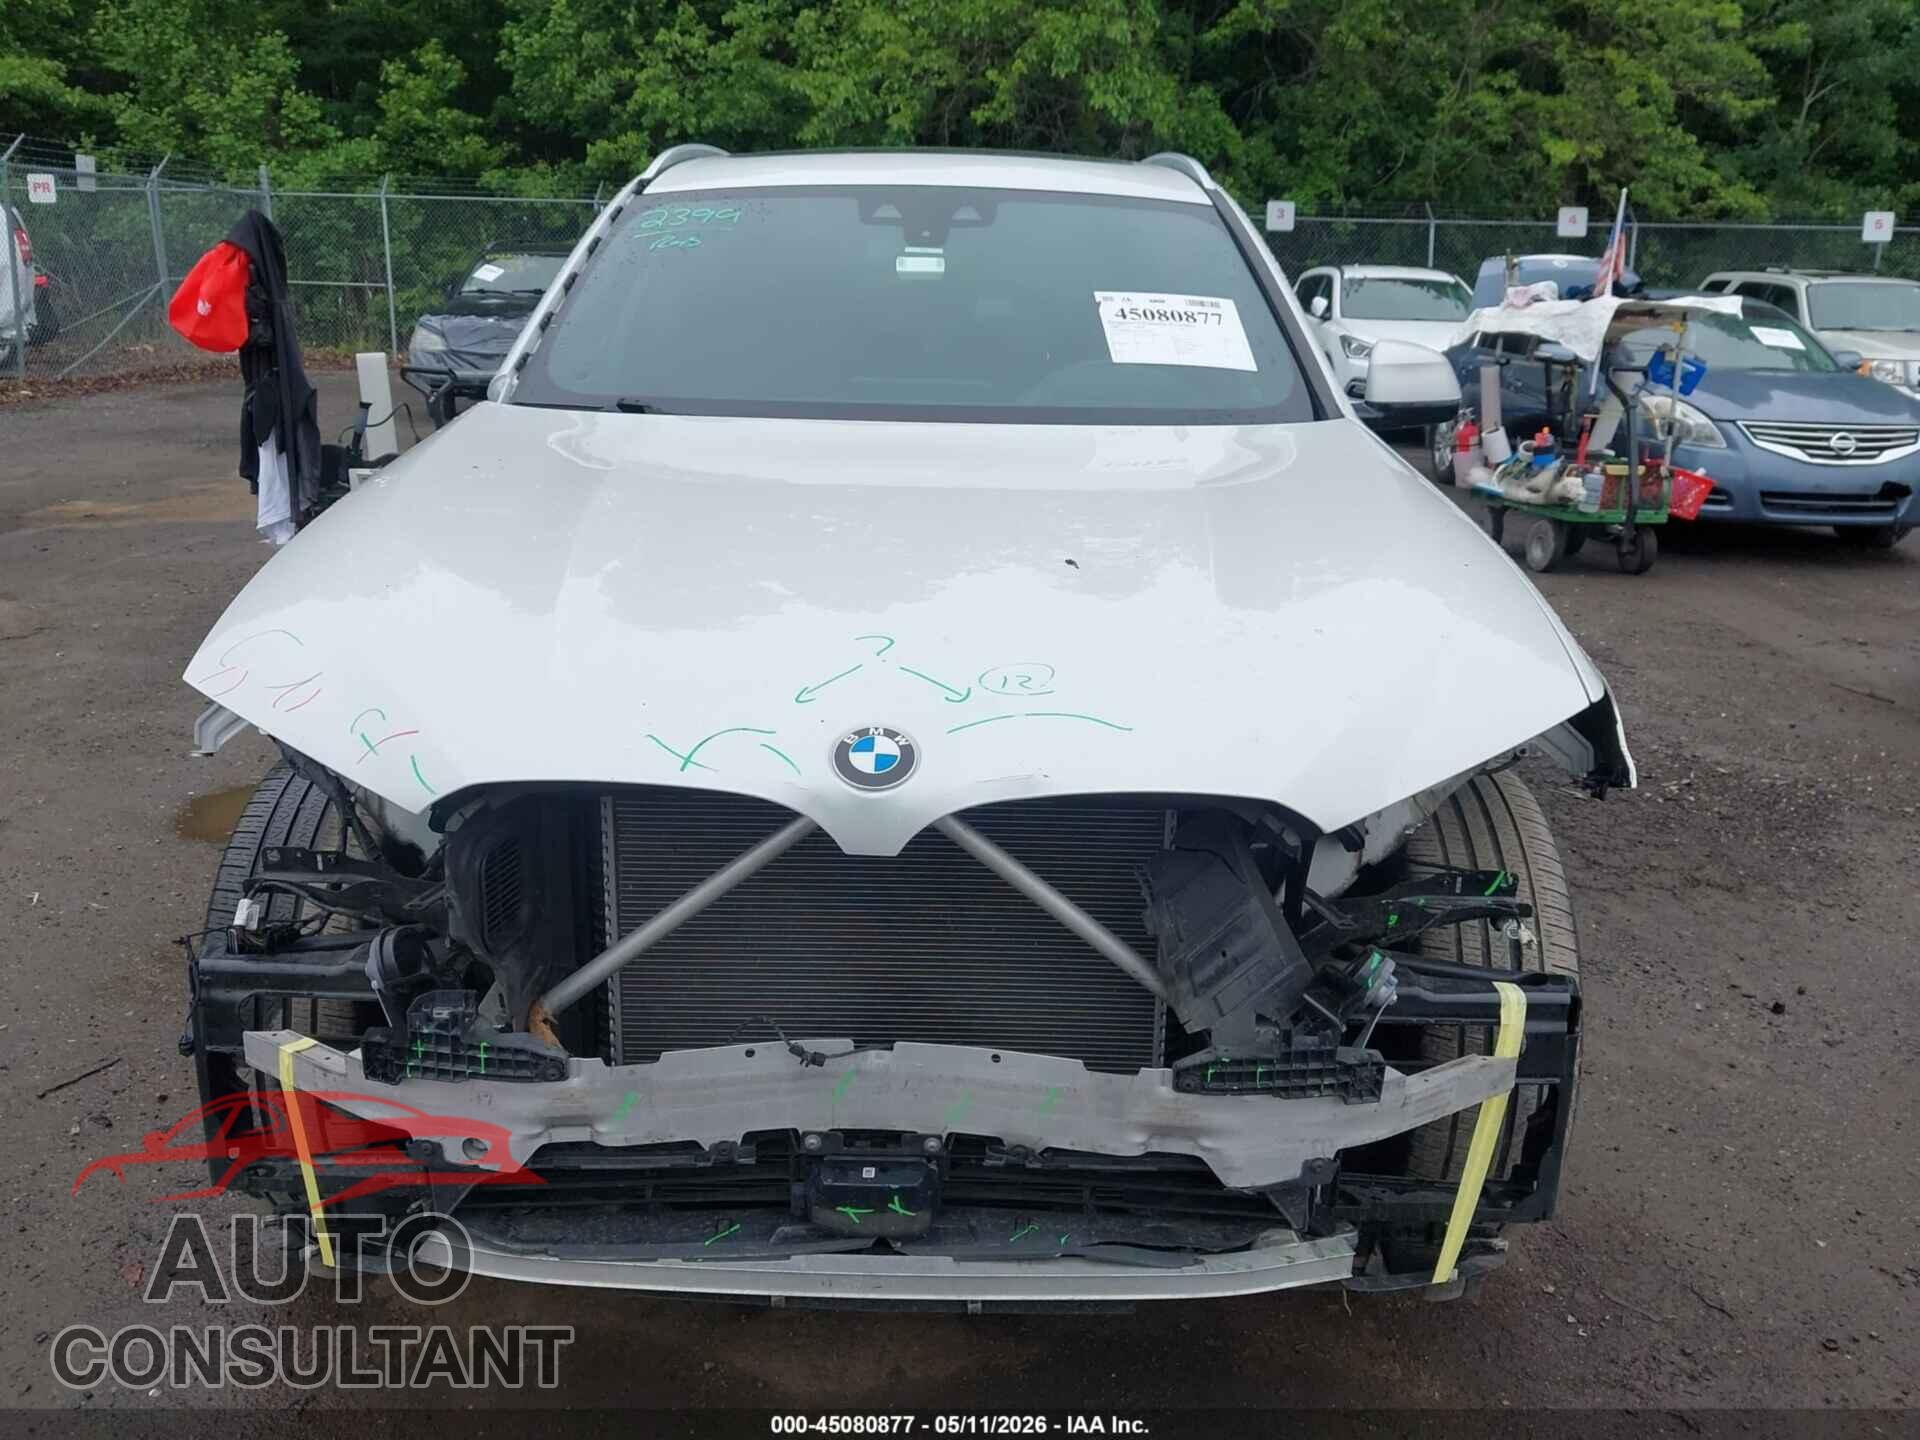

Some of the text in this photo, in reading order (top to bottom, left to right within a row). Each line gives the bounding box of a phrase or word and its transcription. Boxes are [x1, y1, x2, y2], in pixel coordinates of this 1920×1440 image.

[32, 182, 51, 192] PR
[1114, 307, 1223, 326] 45080877
[843, 727, 910, 746] BMW
